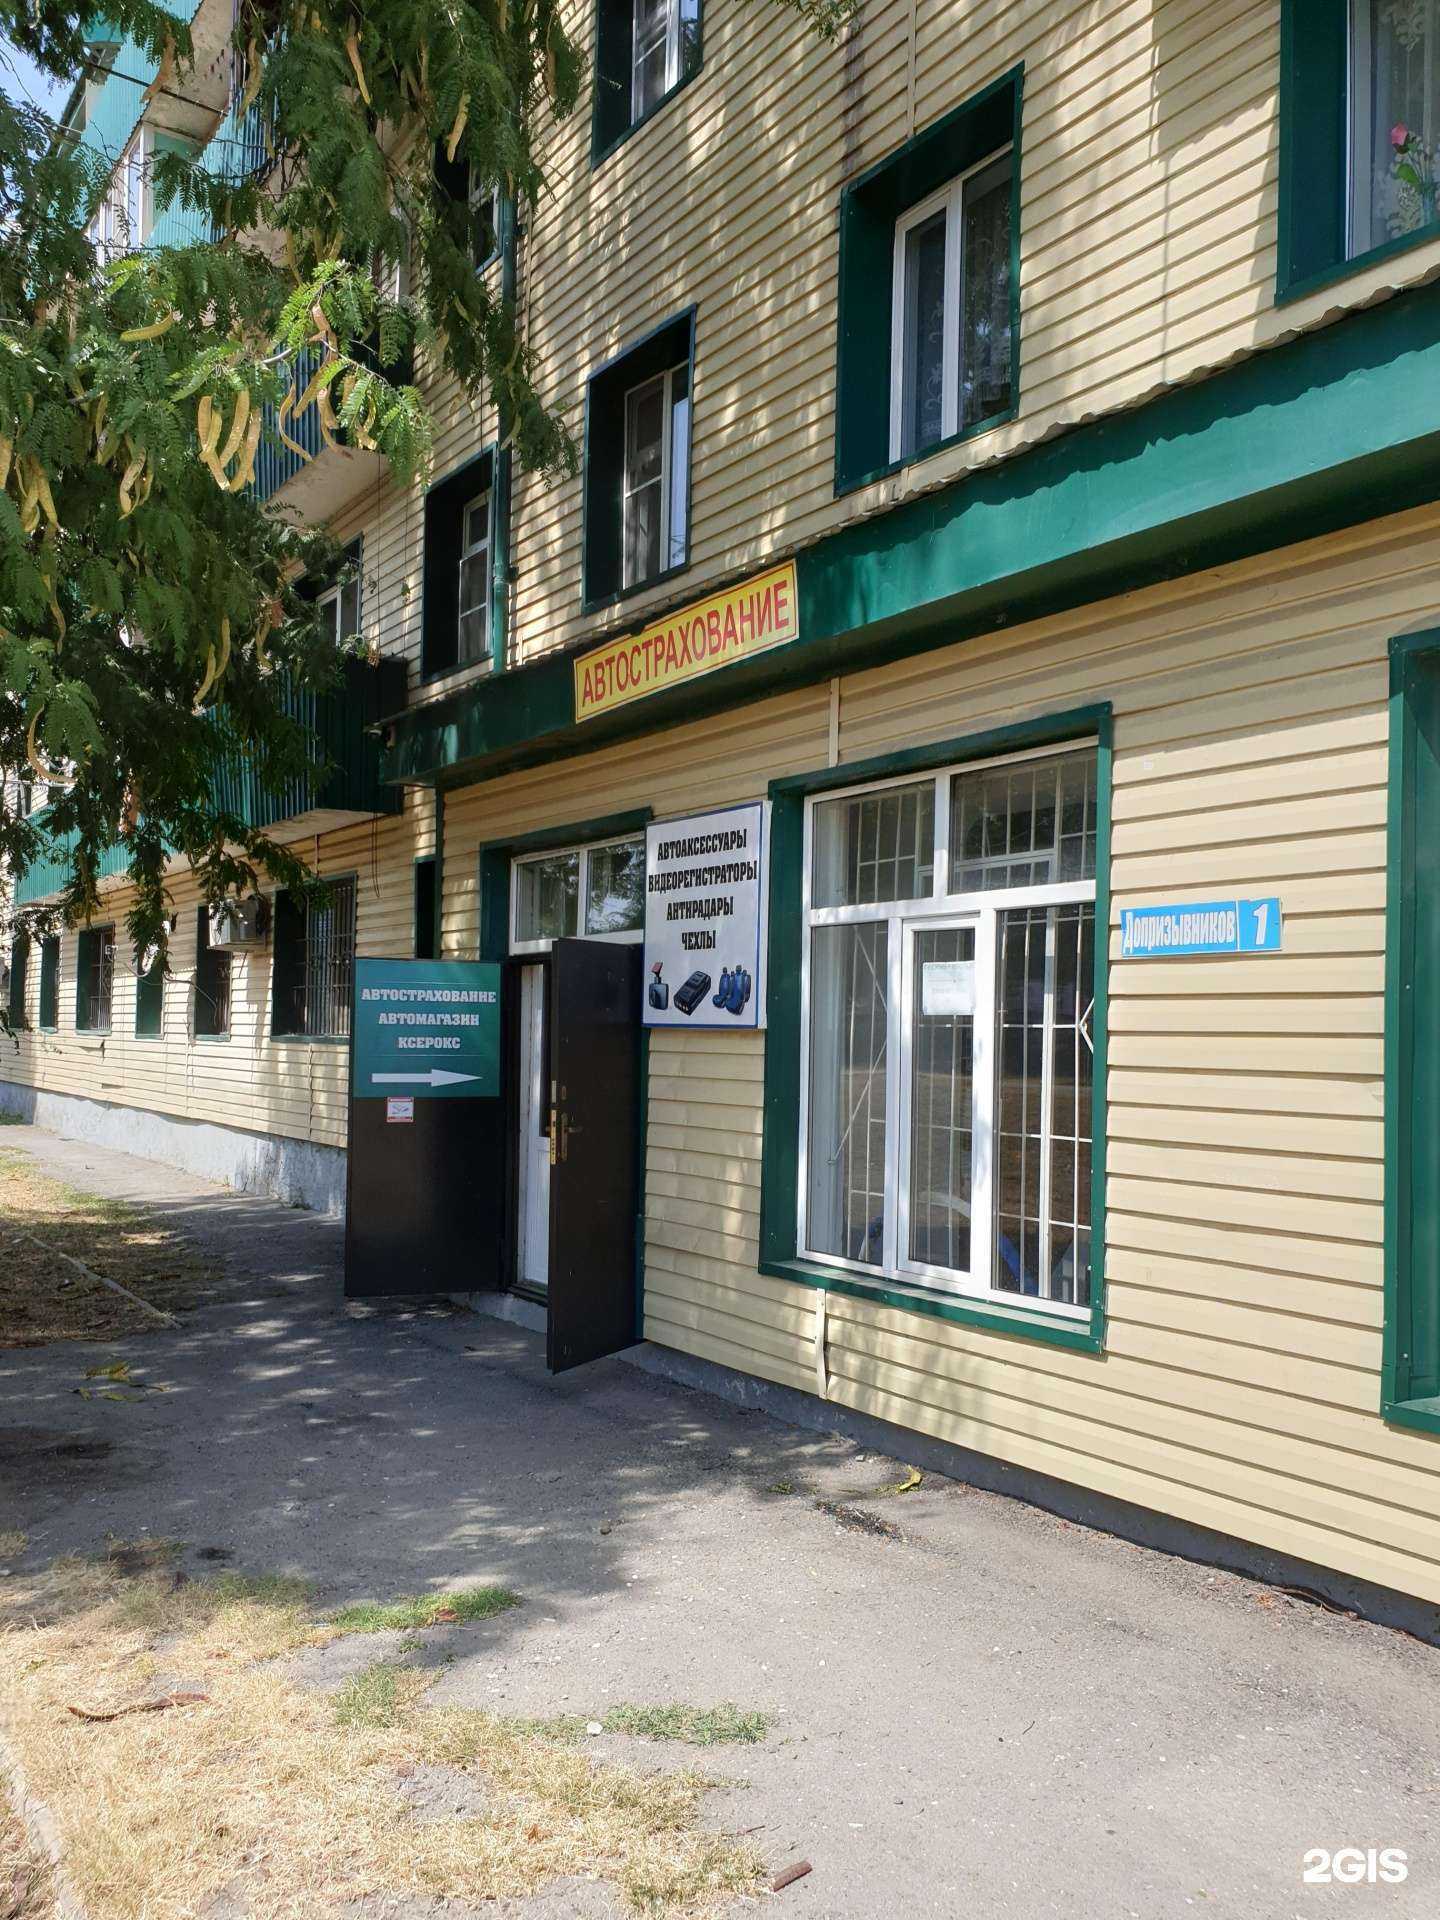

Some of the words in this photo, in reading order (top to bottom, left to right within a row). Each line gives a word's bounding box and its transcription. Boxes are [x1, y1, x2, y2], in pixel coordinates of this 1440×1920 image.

[582, 579, 790, 707] АВТОСТРАХОВАНИЕ
[657, 828, 747, 861] АВТОАКСЕССУАРЫ
[648, 860, 758, 893] ВИДЕОРЕГИСТРАТОРЫ
[666, 896, 734, 921] АНТИРАДАРЫ
[681, 929, 716, 950] ЧЕХЛЫ
[1123, 910, 1235, 953] Допризывников
[1253, 903, 1269, 945] 1
[361, 988, 497, 1003] АВТОСТРАХОВАНИЕ
[378, 1012, 480, 1026] АВТОМАГАЗИН
[398, 1036, 461, 1049] КСЕРОКС
